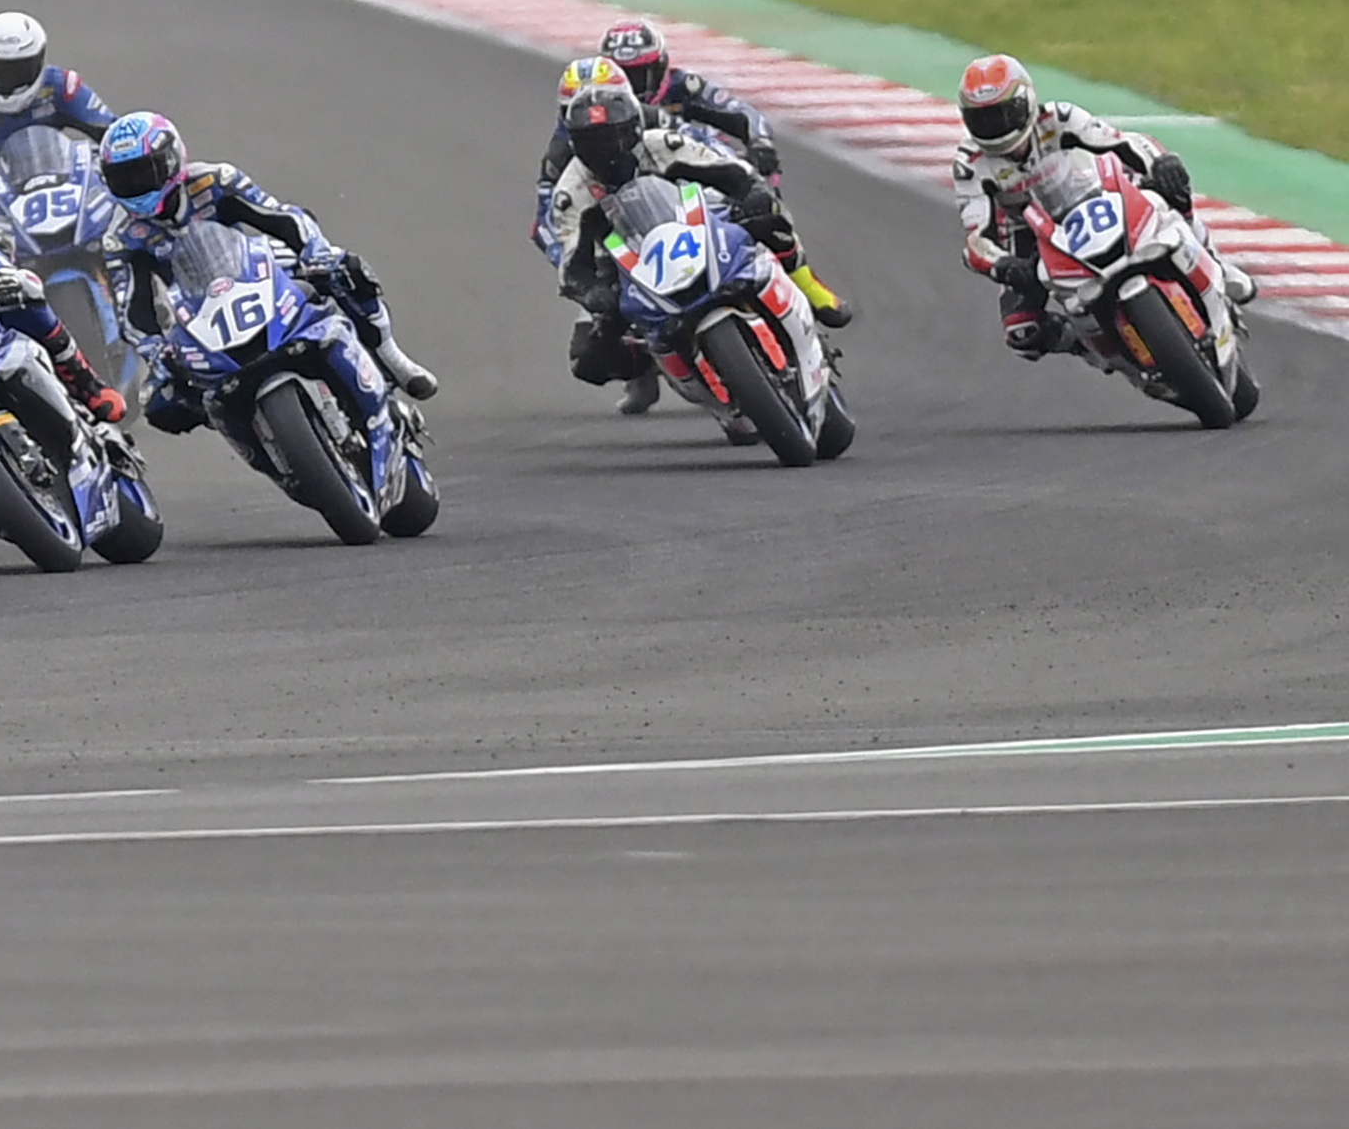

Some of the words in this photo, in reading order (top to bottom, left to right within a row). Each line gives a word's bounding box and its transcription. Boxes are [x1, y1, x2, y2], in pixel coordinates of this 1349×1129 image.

[23, 188, 77, 227] 95
[1064, 199, 1118, 254] 28
[210, 293, 266, 346] 16
